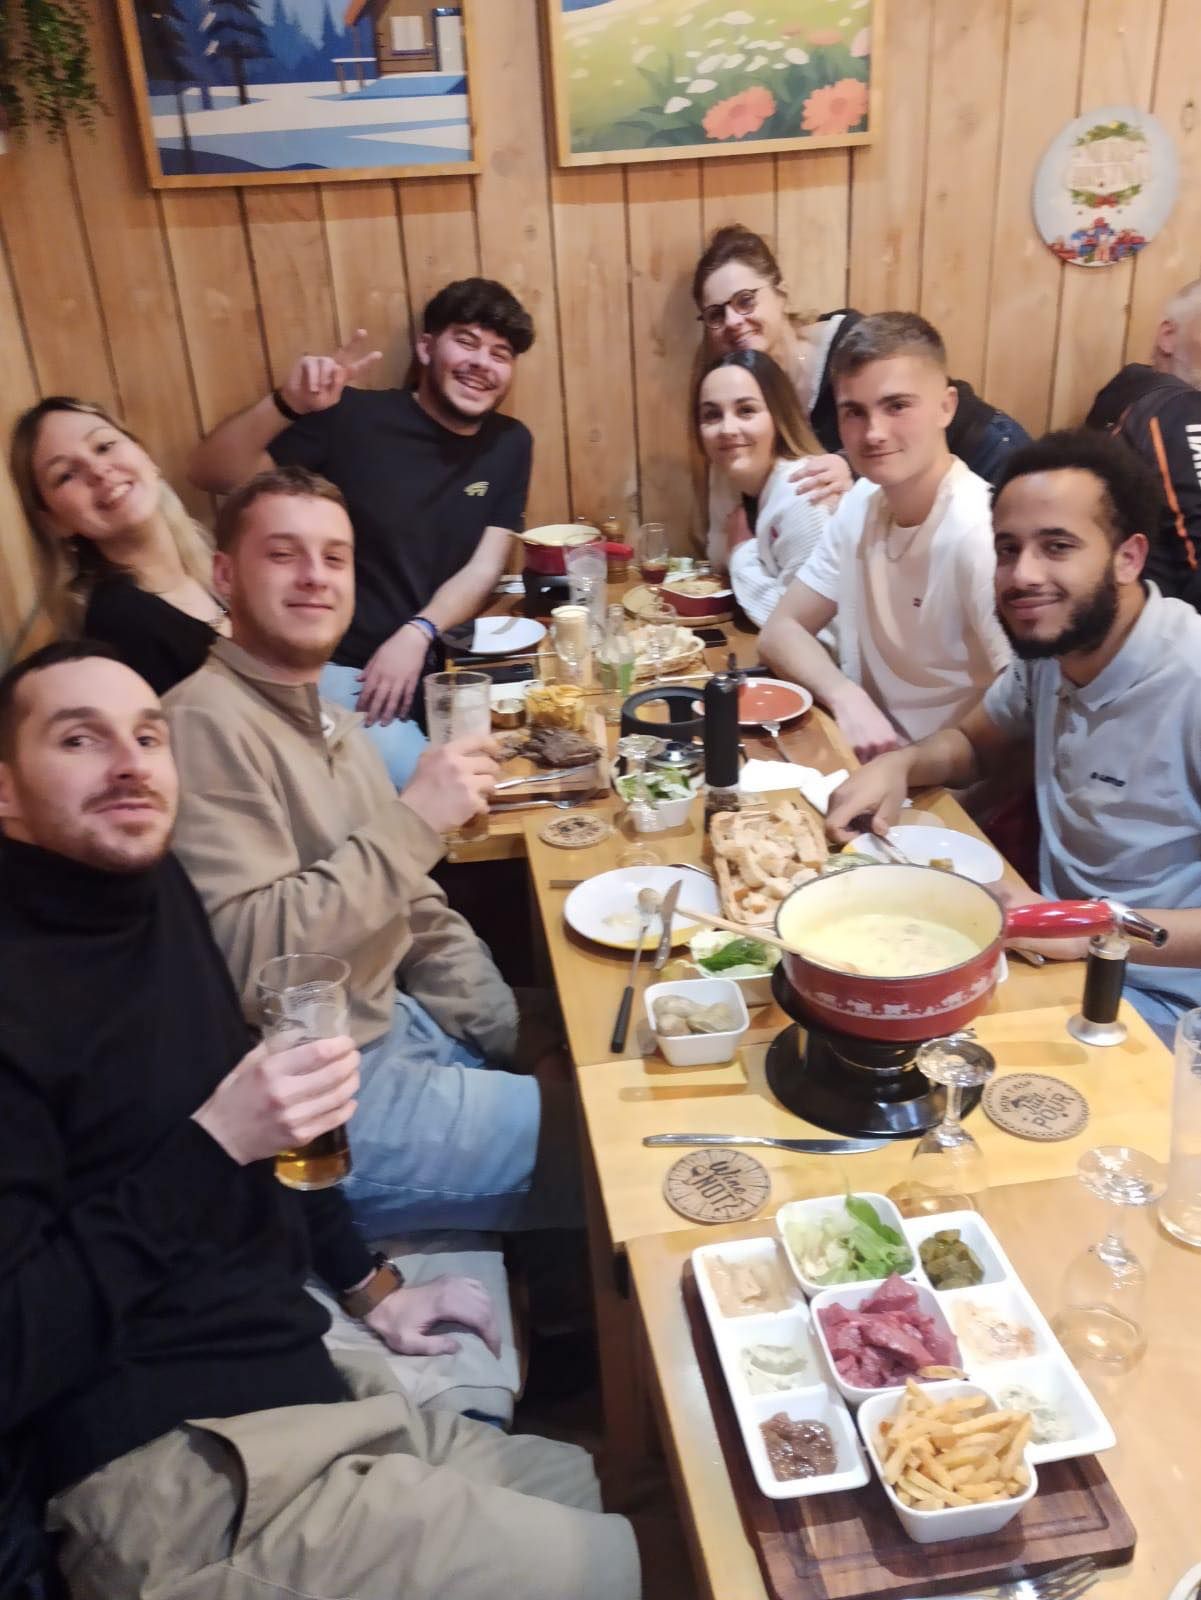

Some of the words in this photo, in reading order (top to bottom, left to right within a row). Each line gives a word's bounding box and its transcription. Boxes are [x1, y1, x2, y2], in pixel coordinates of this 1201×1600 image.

[1032, 1093, 1075, 1130] POUR
[690, 1173, 744, 1212] NOT?
[709, 1161, 747, 1194] Wine
